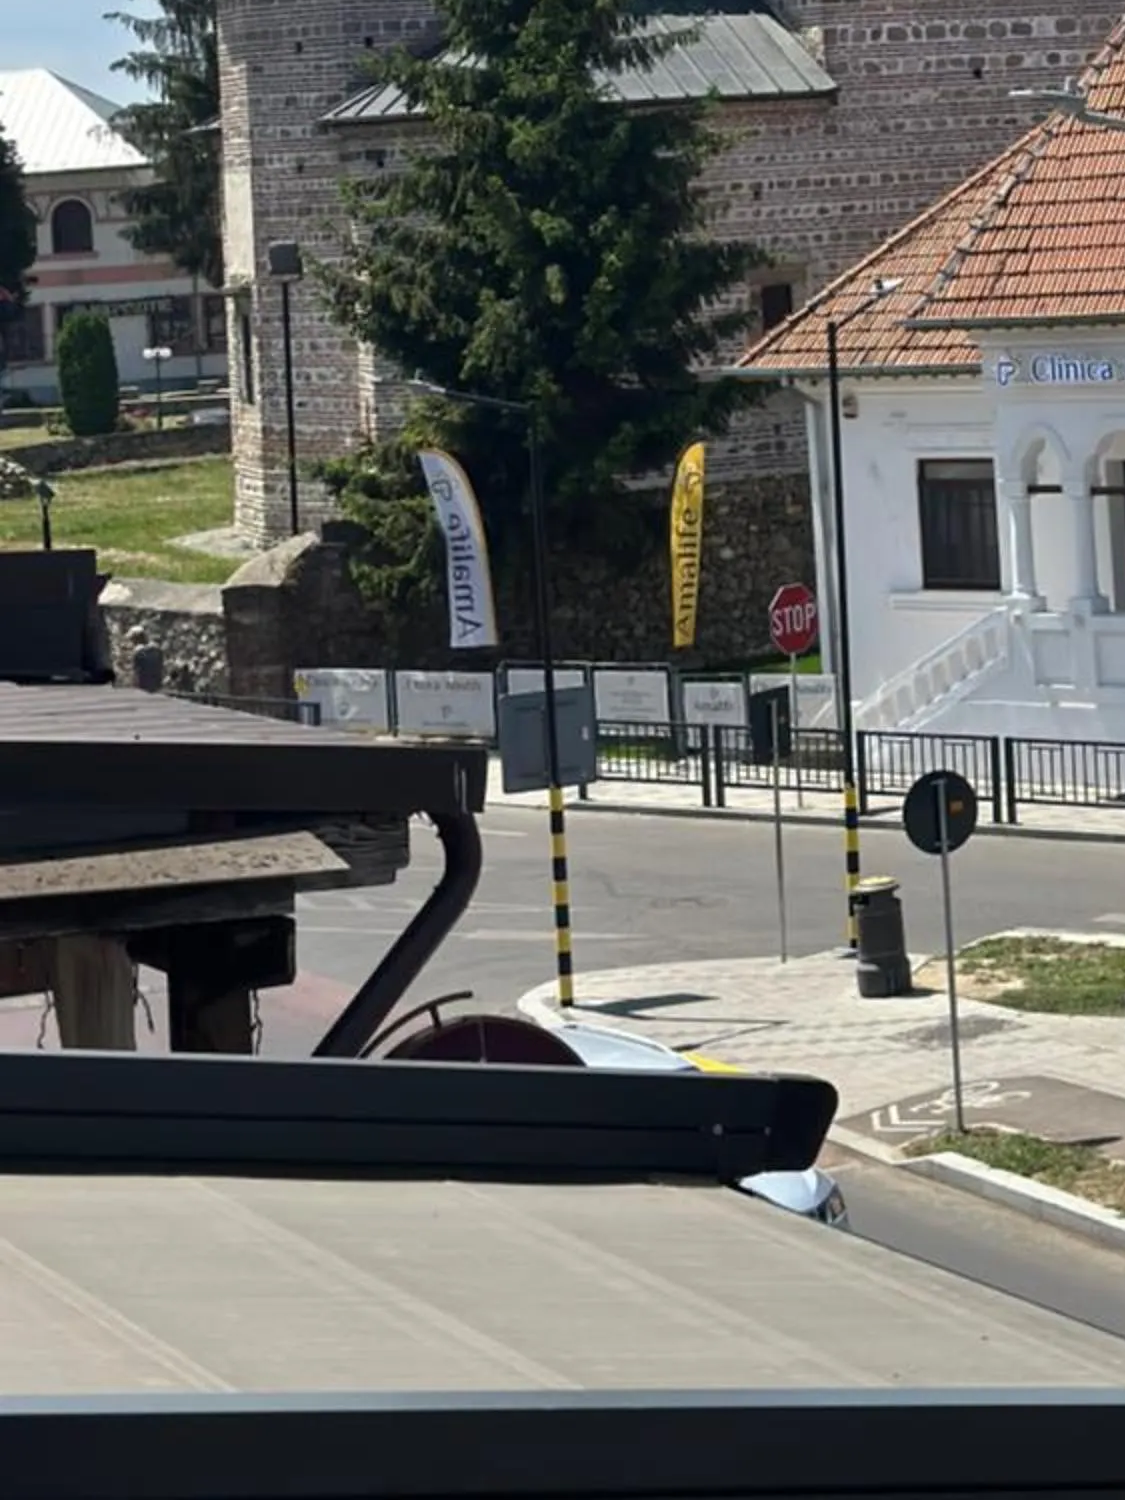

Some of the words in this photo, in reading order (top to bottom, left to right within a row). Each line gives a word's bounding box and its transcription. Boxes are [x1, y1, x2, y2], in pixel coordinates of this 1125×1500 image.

[1032, 355, 1113, 381] Clinica
[675, 507, 698, 638] Amalife
[772, 603, 816, 637] STOP
